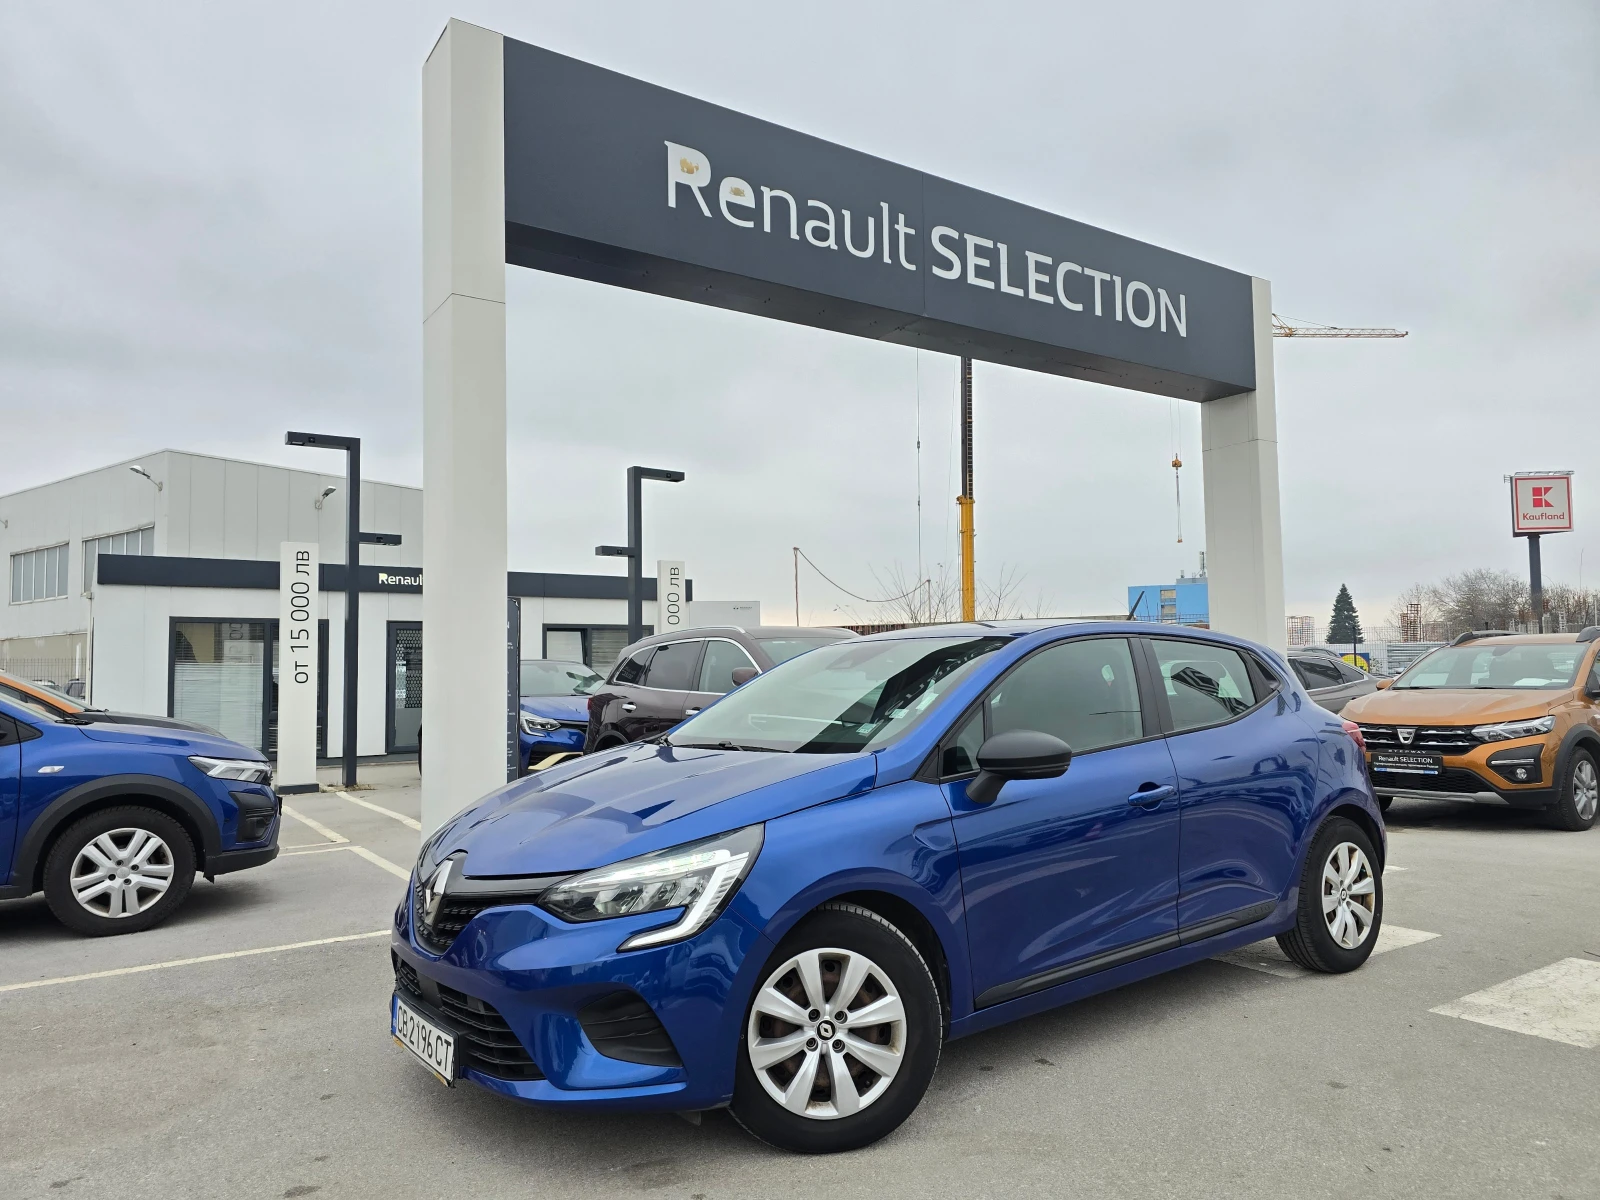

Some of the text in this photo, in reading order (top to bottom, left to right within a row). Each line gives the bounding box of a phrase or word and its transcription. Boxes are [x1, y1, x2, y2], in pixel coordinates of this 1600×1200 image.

[664, 140, 1187, 338] Renault SELECTION
[1522, 512, 1565, 521] Kaufland
[378, 572, 423, 586] Renaul
[290, 582, 310, 622] 000
[667, 592, 680, 625] 000
[290, 629, 310, 653] 15
[294, 661, 309, 684] от
[1400, 756, 1433, 764] SELECTION
